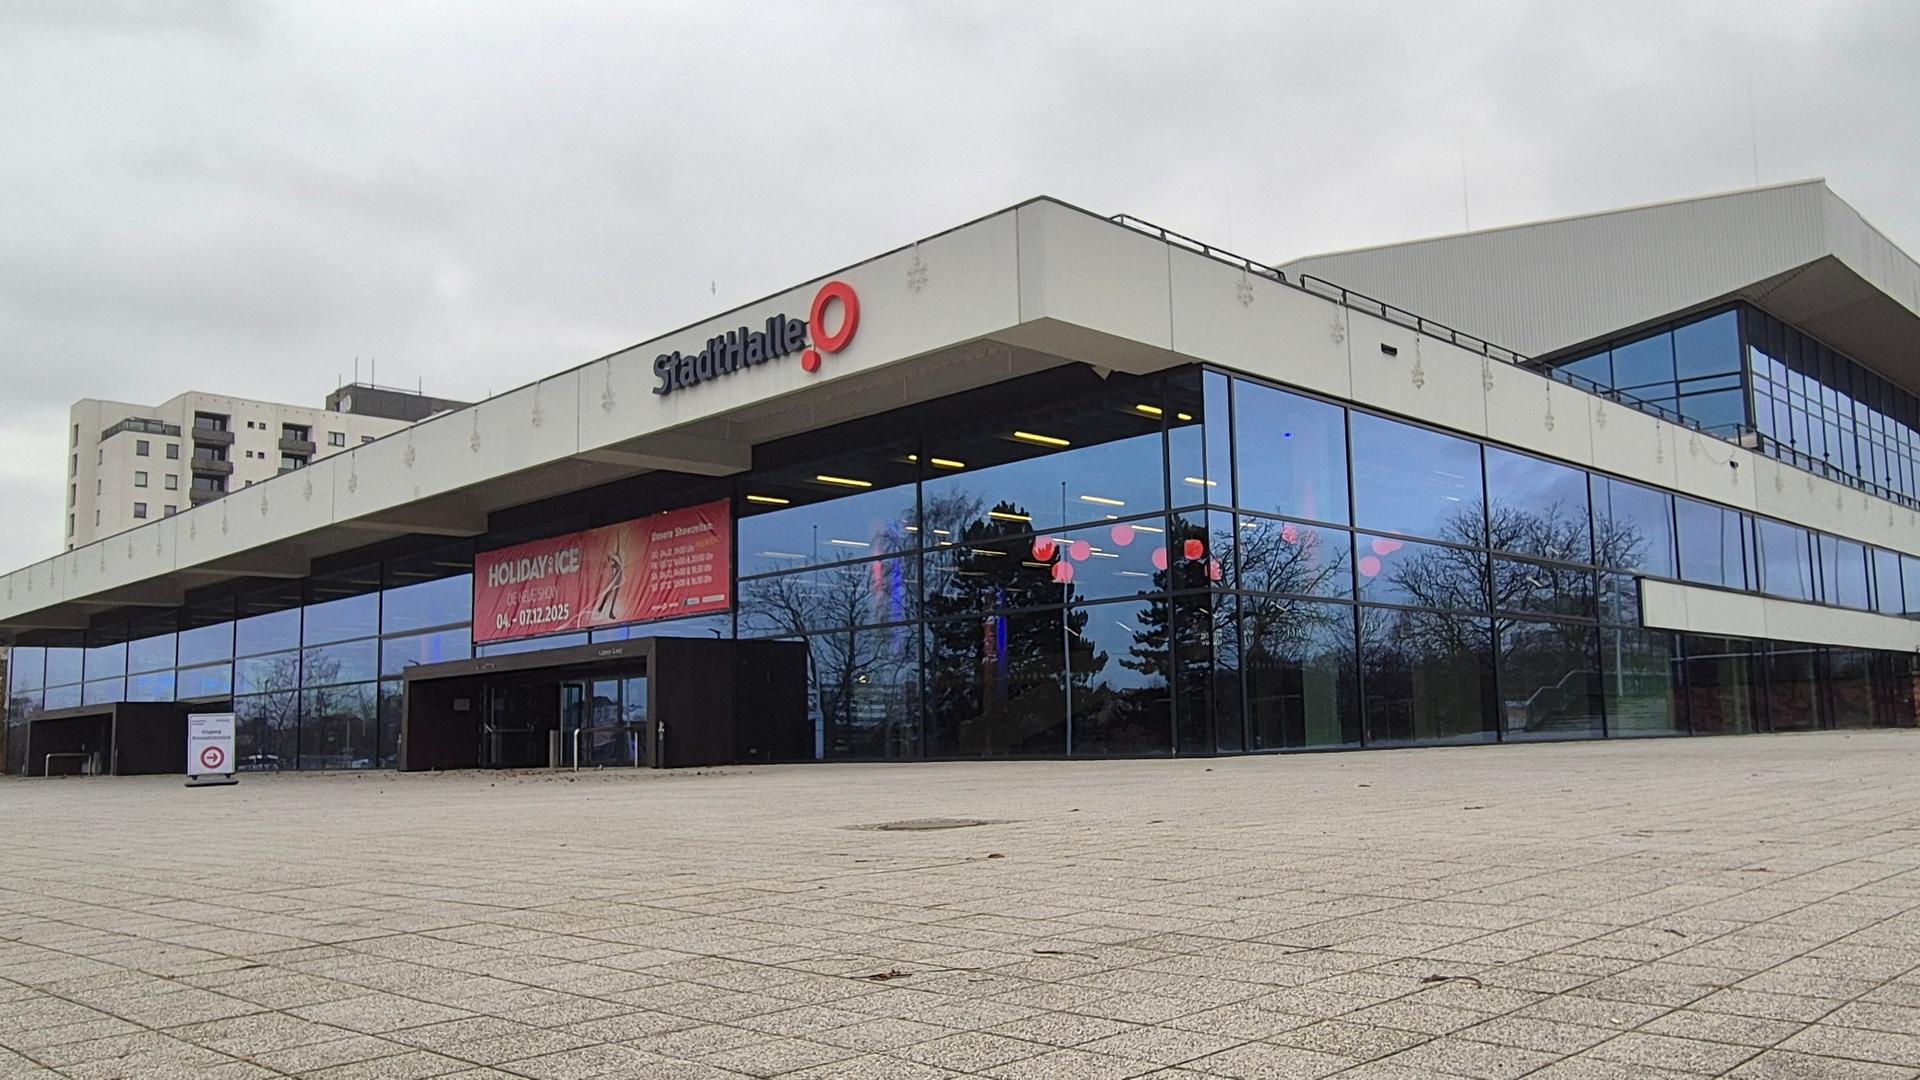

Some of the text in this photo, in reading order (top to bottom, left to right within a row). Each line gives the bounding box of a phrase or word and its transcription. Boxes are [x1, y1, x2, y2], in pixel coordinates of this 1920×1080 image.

[652, 313, 807, 396] StadtHalle
[488, 554, 549, 588] HOLIDAY
[555, 548, 580, 575] ICE
[496, 613, 511, 629] 04.
[519, 603, 569, 626] 07.12.2025
